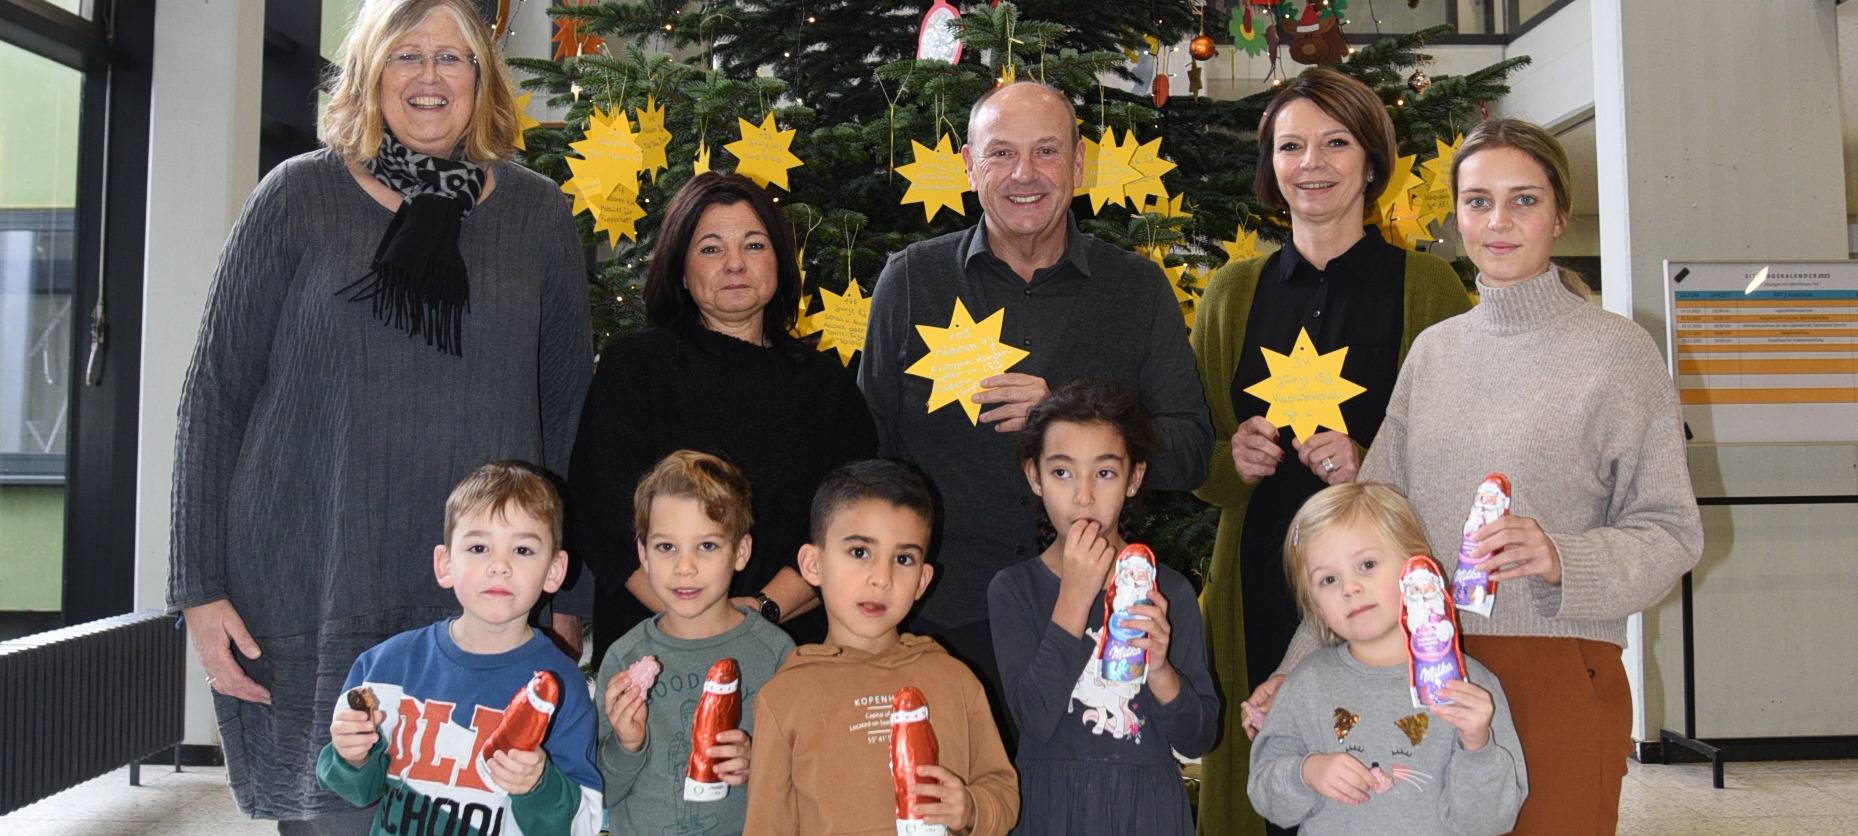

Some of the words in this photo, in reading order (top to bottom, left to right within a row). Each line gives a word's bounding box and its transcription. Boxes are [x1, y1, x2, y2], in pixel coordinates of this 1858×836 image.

[1454, 568, 1482, 583] Milka
[1109, 645, 1142, 660] Milka
[1420, 661, 1453, 683] Milka
[854, 694, 895, 706] KOPENH
[383, 788, 504, 836] CHOO
